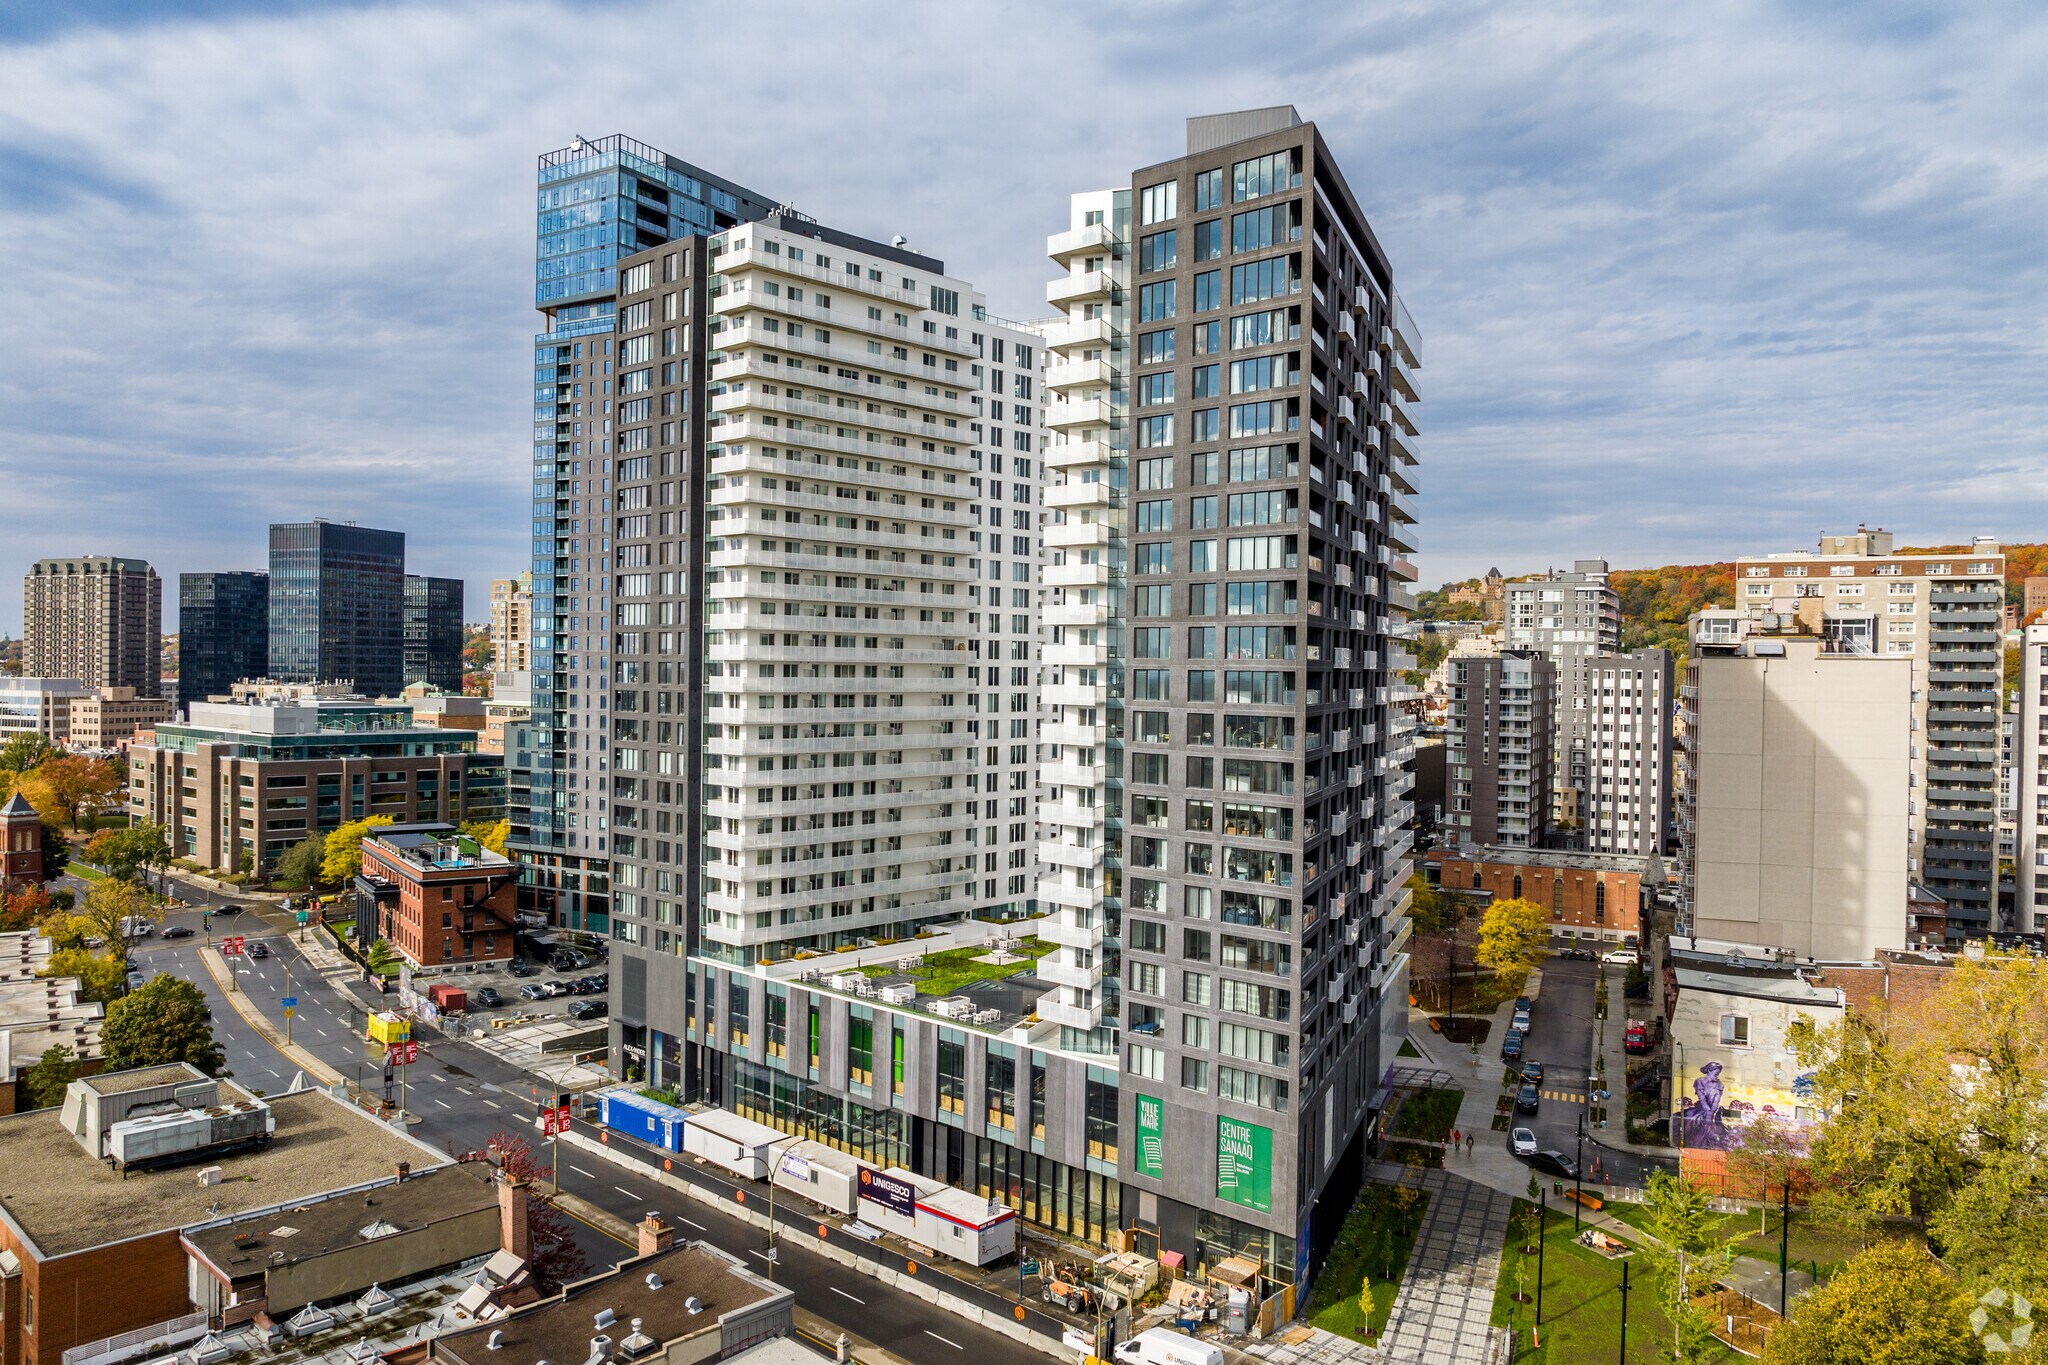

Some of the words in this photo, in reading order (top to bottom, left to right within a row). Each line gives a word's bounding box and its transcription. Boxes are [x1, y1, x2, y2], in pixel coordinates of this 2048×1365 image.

[623, 1043, 646, 1056] ALEXANDER
[1141, 1100, 1159, 1119] VILLE
[1141, 1111, 1159, 1131] MARIE
[1220, 1121, 1251, 1144] CENTRE
[1220, 1137, 1253, 1161] SANAAQ
[872, 1176, 910, 1198] UNIGESCO
[769, 1251, 776, 1260] 50
